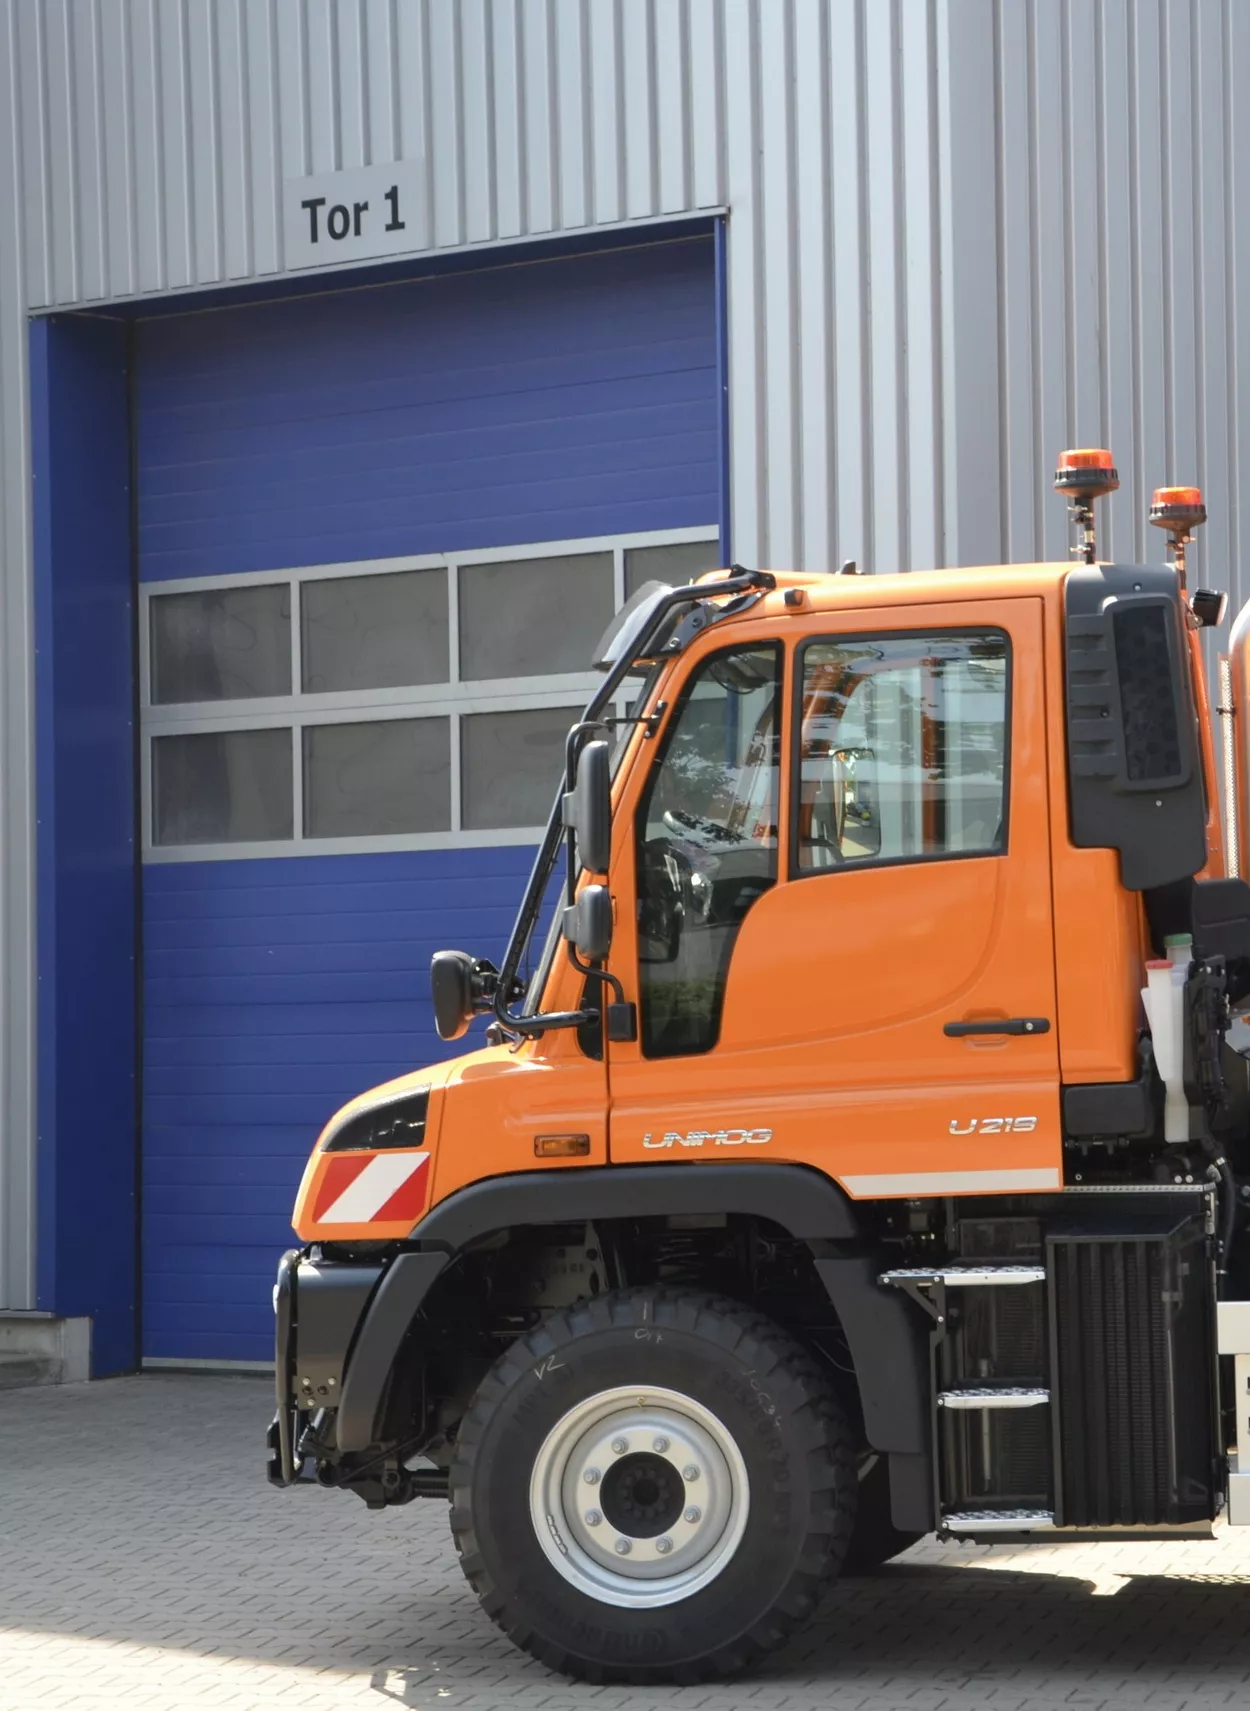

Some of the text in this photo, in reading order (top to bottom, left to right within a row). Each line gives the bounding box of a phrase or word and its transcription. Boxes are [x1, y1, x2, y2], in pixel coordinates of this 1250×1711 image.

[301, 185, 405, 243] Tor 1
[643, 1128, 773, 1149] UNIMOG
